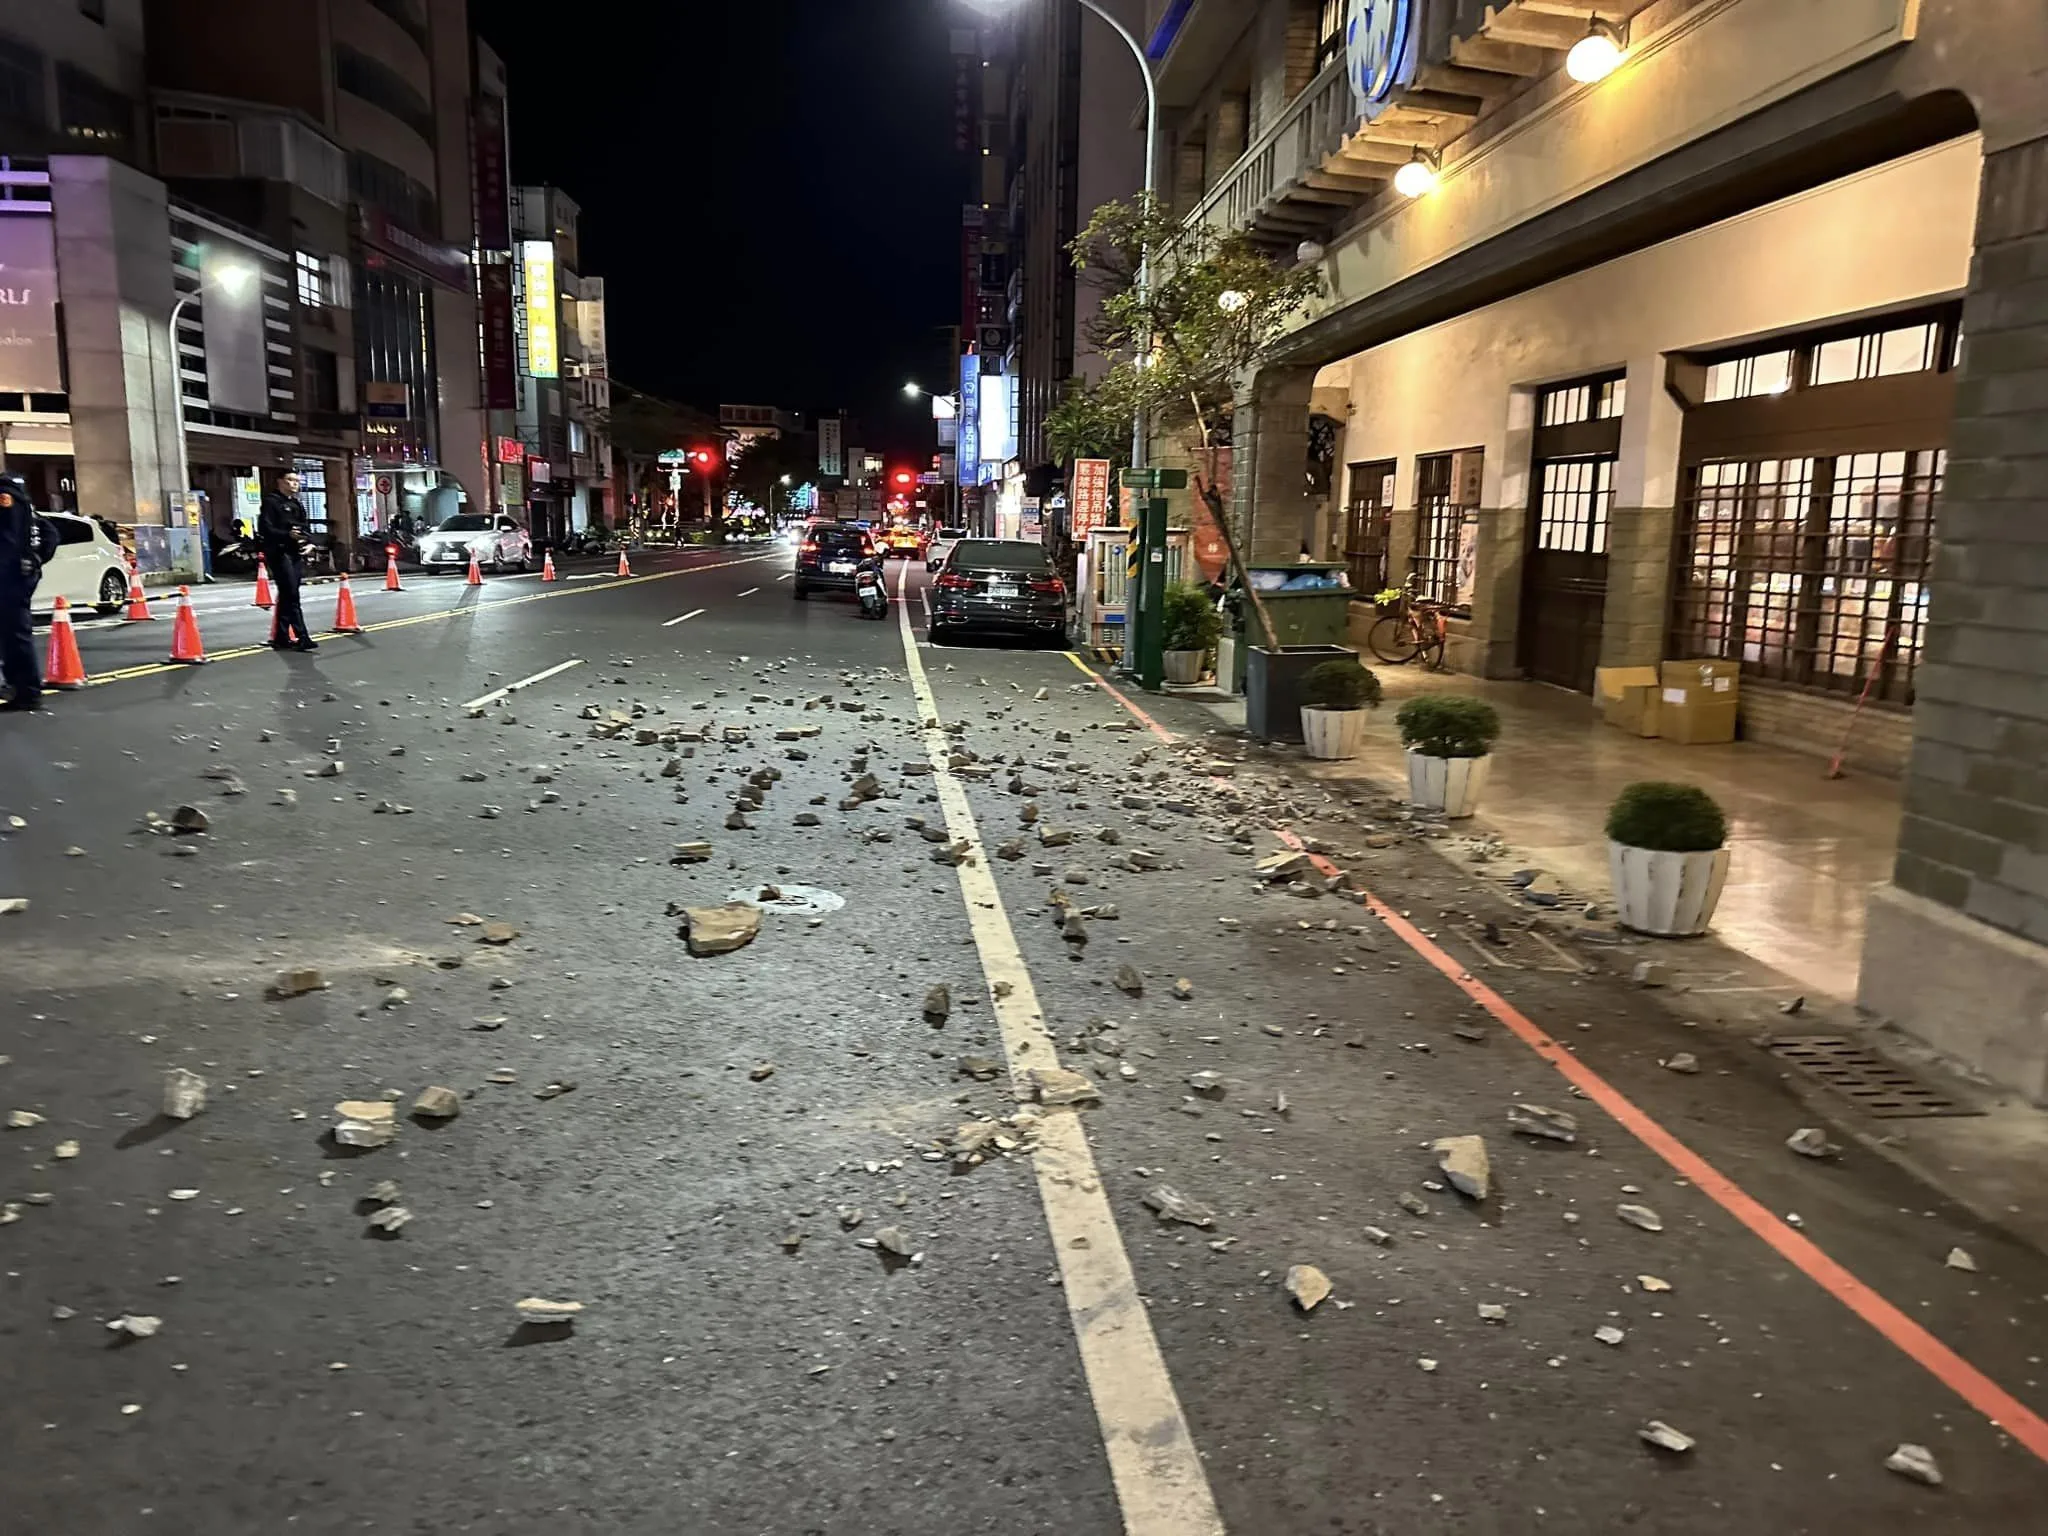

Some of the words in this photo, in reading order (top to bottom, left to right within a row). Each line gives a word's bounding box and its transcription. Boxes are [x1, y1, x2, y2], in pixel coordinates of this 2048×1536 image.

[1089, 464, 1105, 527] 加強拖吊路
